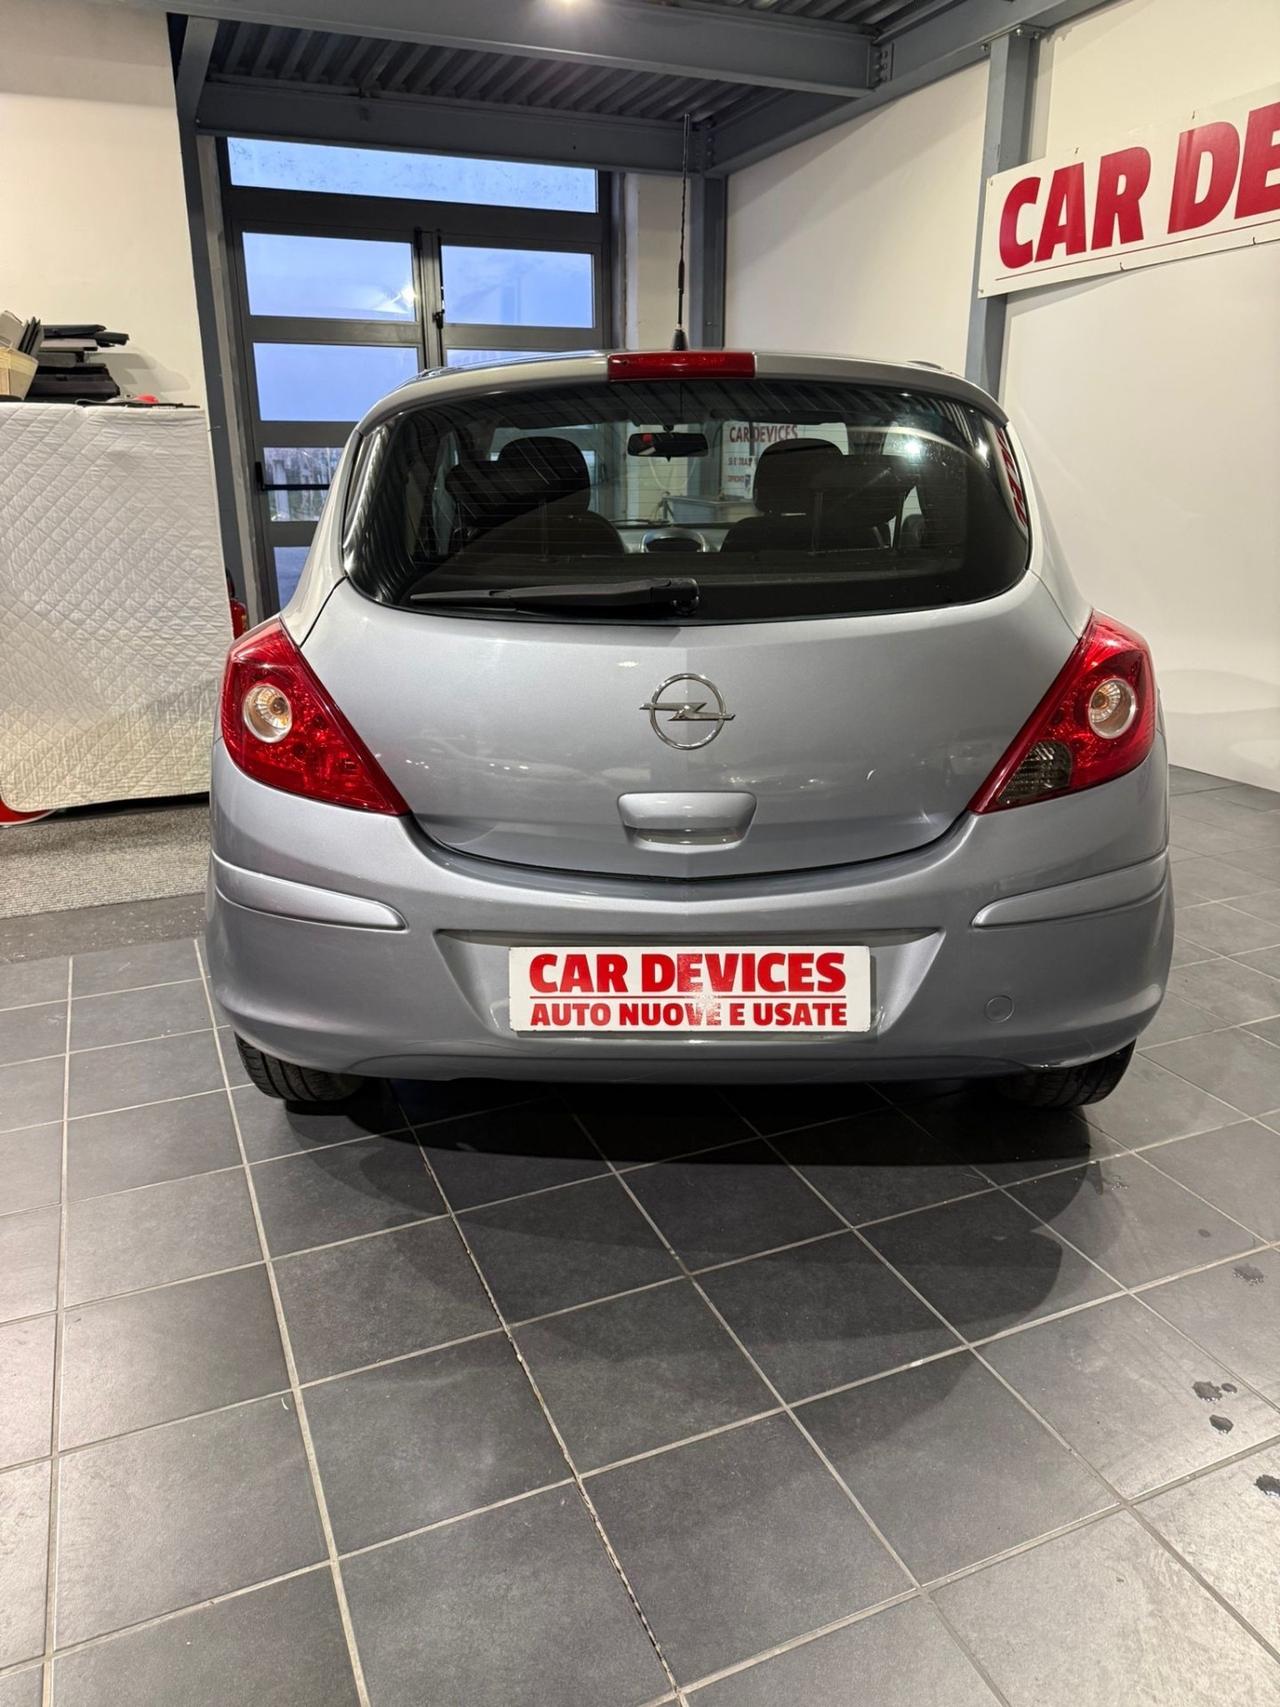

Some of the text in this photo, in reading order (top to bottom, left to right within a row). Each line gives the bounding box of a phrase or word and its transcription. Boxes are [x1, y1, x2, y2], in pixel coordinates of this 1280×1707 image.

[999, 147, 1151, 268] CAR
[729, 427, 750, 443] CAR
[529, 952, 847, 993] CAR DEVICES
[530, 1002, 848, 1027] AUTO NUOVE E USATE
